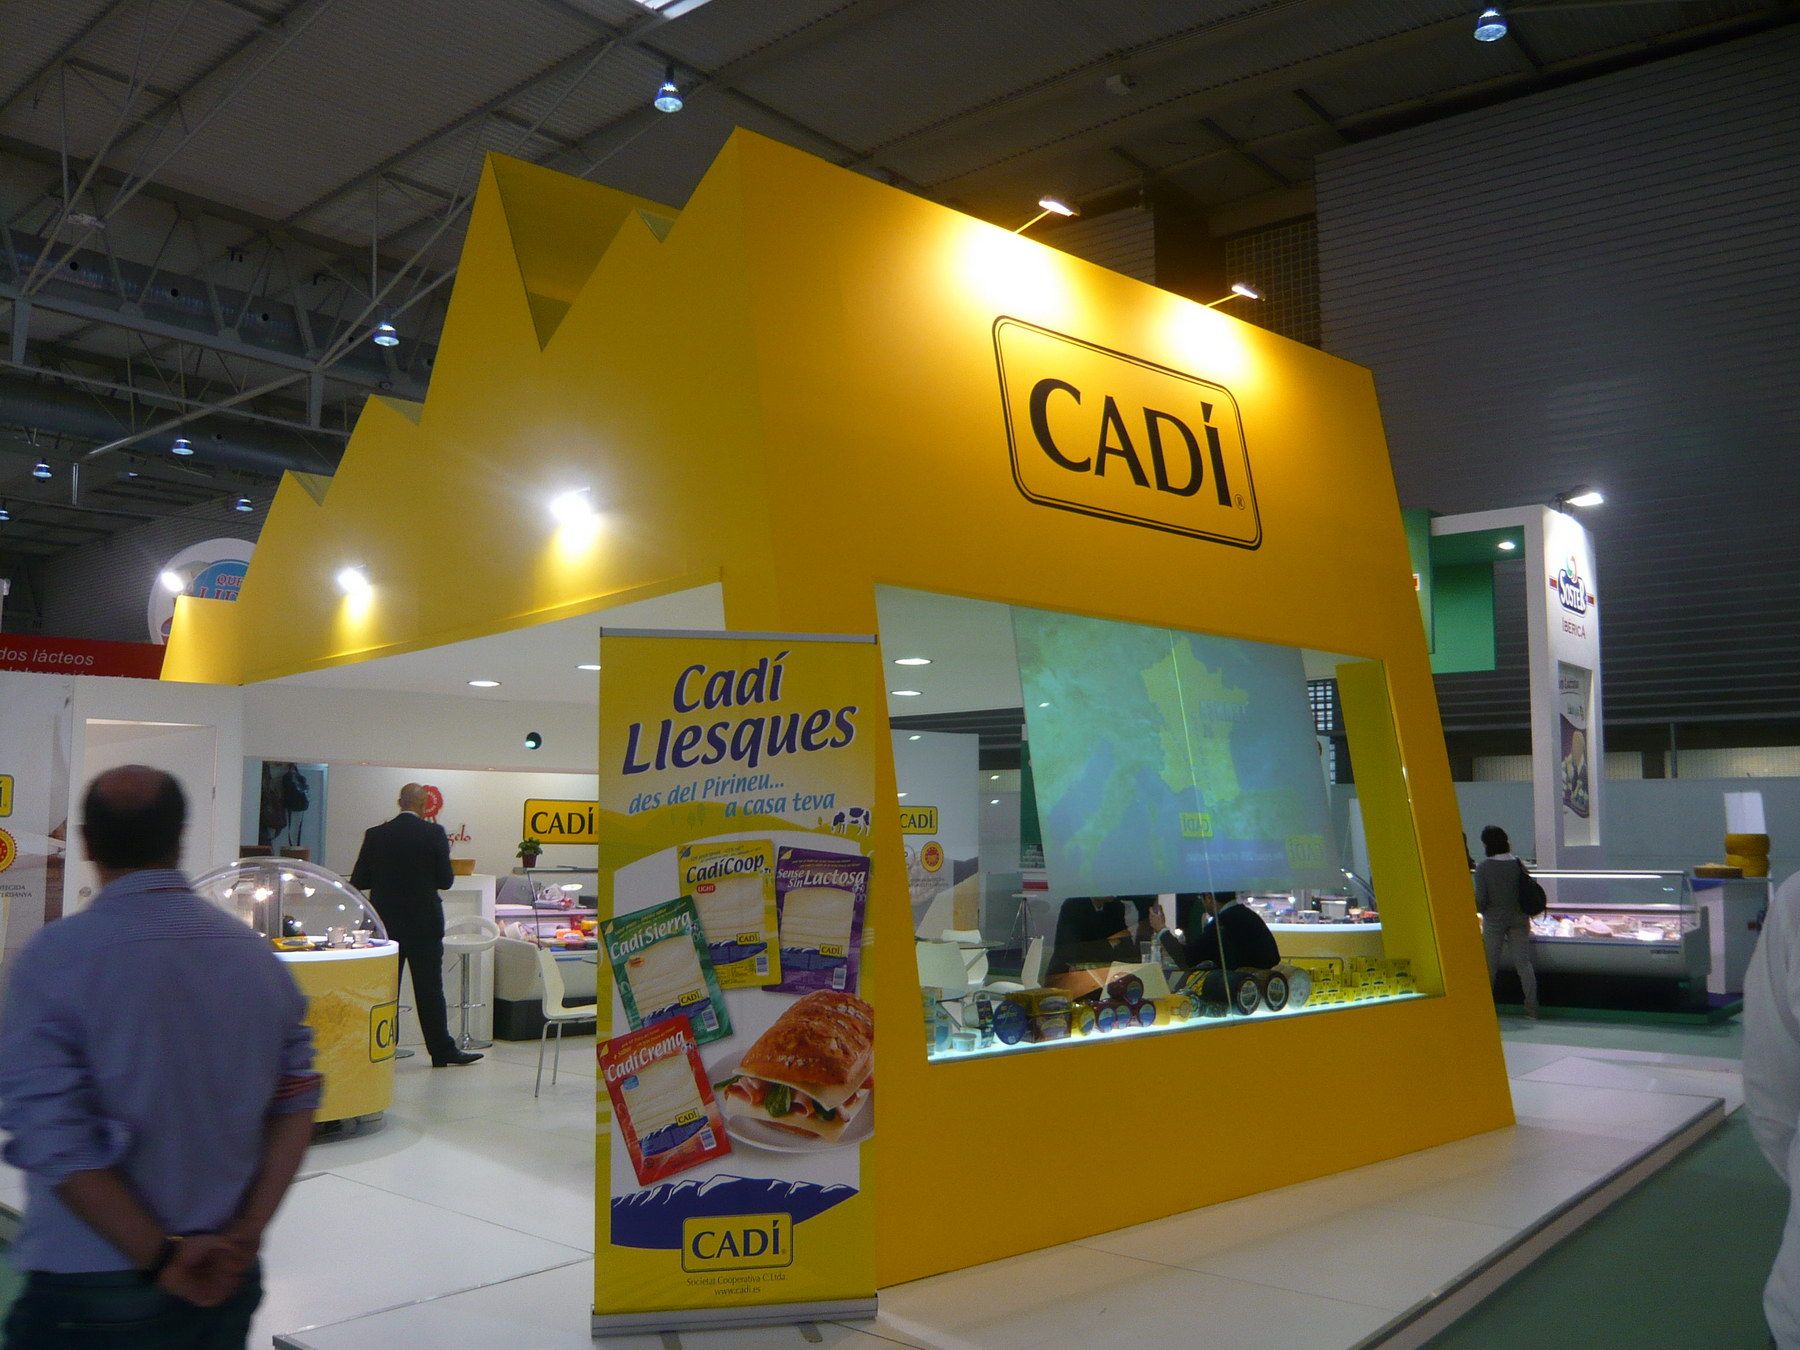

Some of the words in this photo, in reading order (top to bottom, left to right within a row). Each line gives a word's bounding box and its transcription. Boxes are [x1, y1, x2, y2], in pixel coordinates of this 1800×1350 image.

[1029, 378, 1232, 508] CADÍ
[32, 649, 95, 666] lácteos
[673, 650, 791, 713] Cadí
[622, 705, 858, 775] Llesques
[629, 793, 661, 815] des
[667, 783, 696, 805] del
[702, 772, 785, 799] Pirineu...
[725, 802, 737, 817] a
[743, 797, 785, 816] casa
[793, 793, 835, 811] teva
[531, 806, 594, 835] CADÍ
[900, 809, 933, 829] CADÍ
[777, 868, 804, 879] Sense
[803, 869, 866, 886] Lactosa
[788, 878, 803, 888] Sin
[376, 1013, 398, 1049] CA
[692, 1220, 780, 1260] CADÍ
[717, 1274, 761, 1286] Cooperativa
